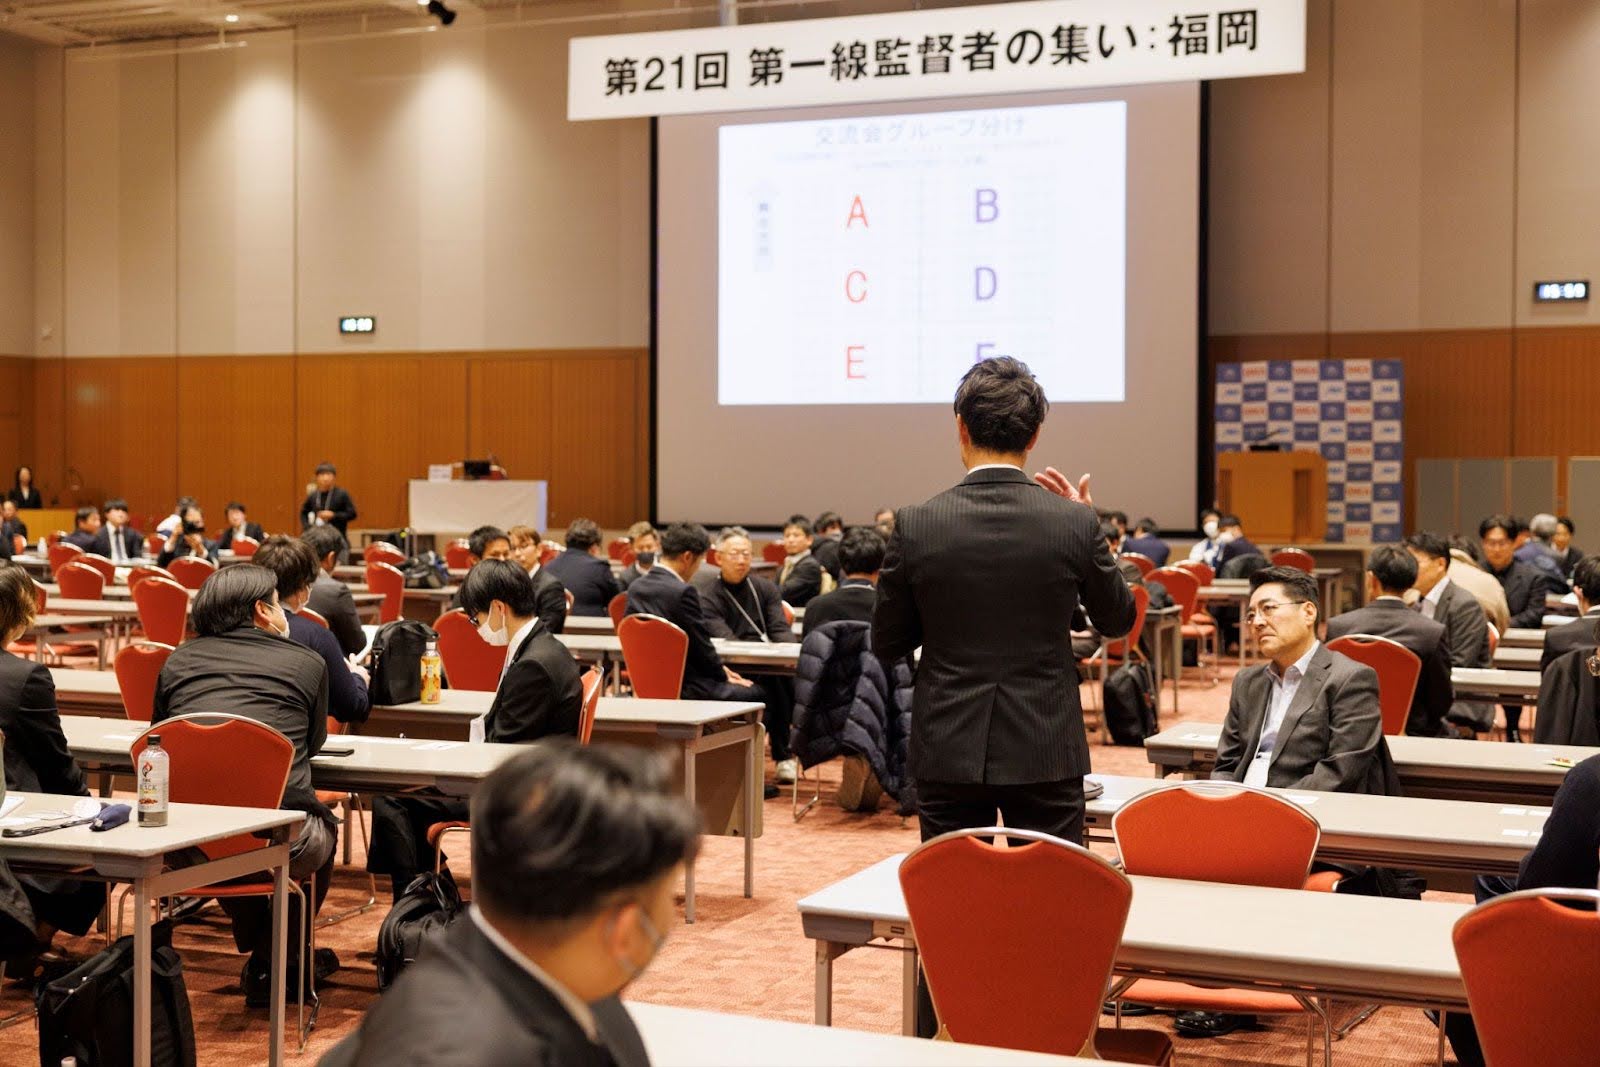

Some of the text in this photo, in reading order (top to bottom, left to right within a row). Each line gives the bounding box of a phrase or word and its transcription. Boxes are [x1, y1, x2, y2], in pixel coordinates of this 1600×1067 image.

[604, 51, 728, 96] 第21回
[846, 195, 870, 228] A
[975, 188, 999, 224] B
[845, 270, 868, 304] C
[975, 266, 997, 301] D
[846, 345, 866, 379] E
